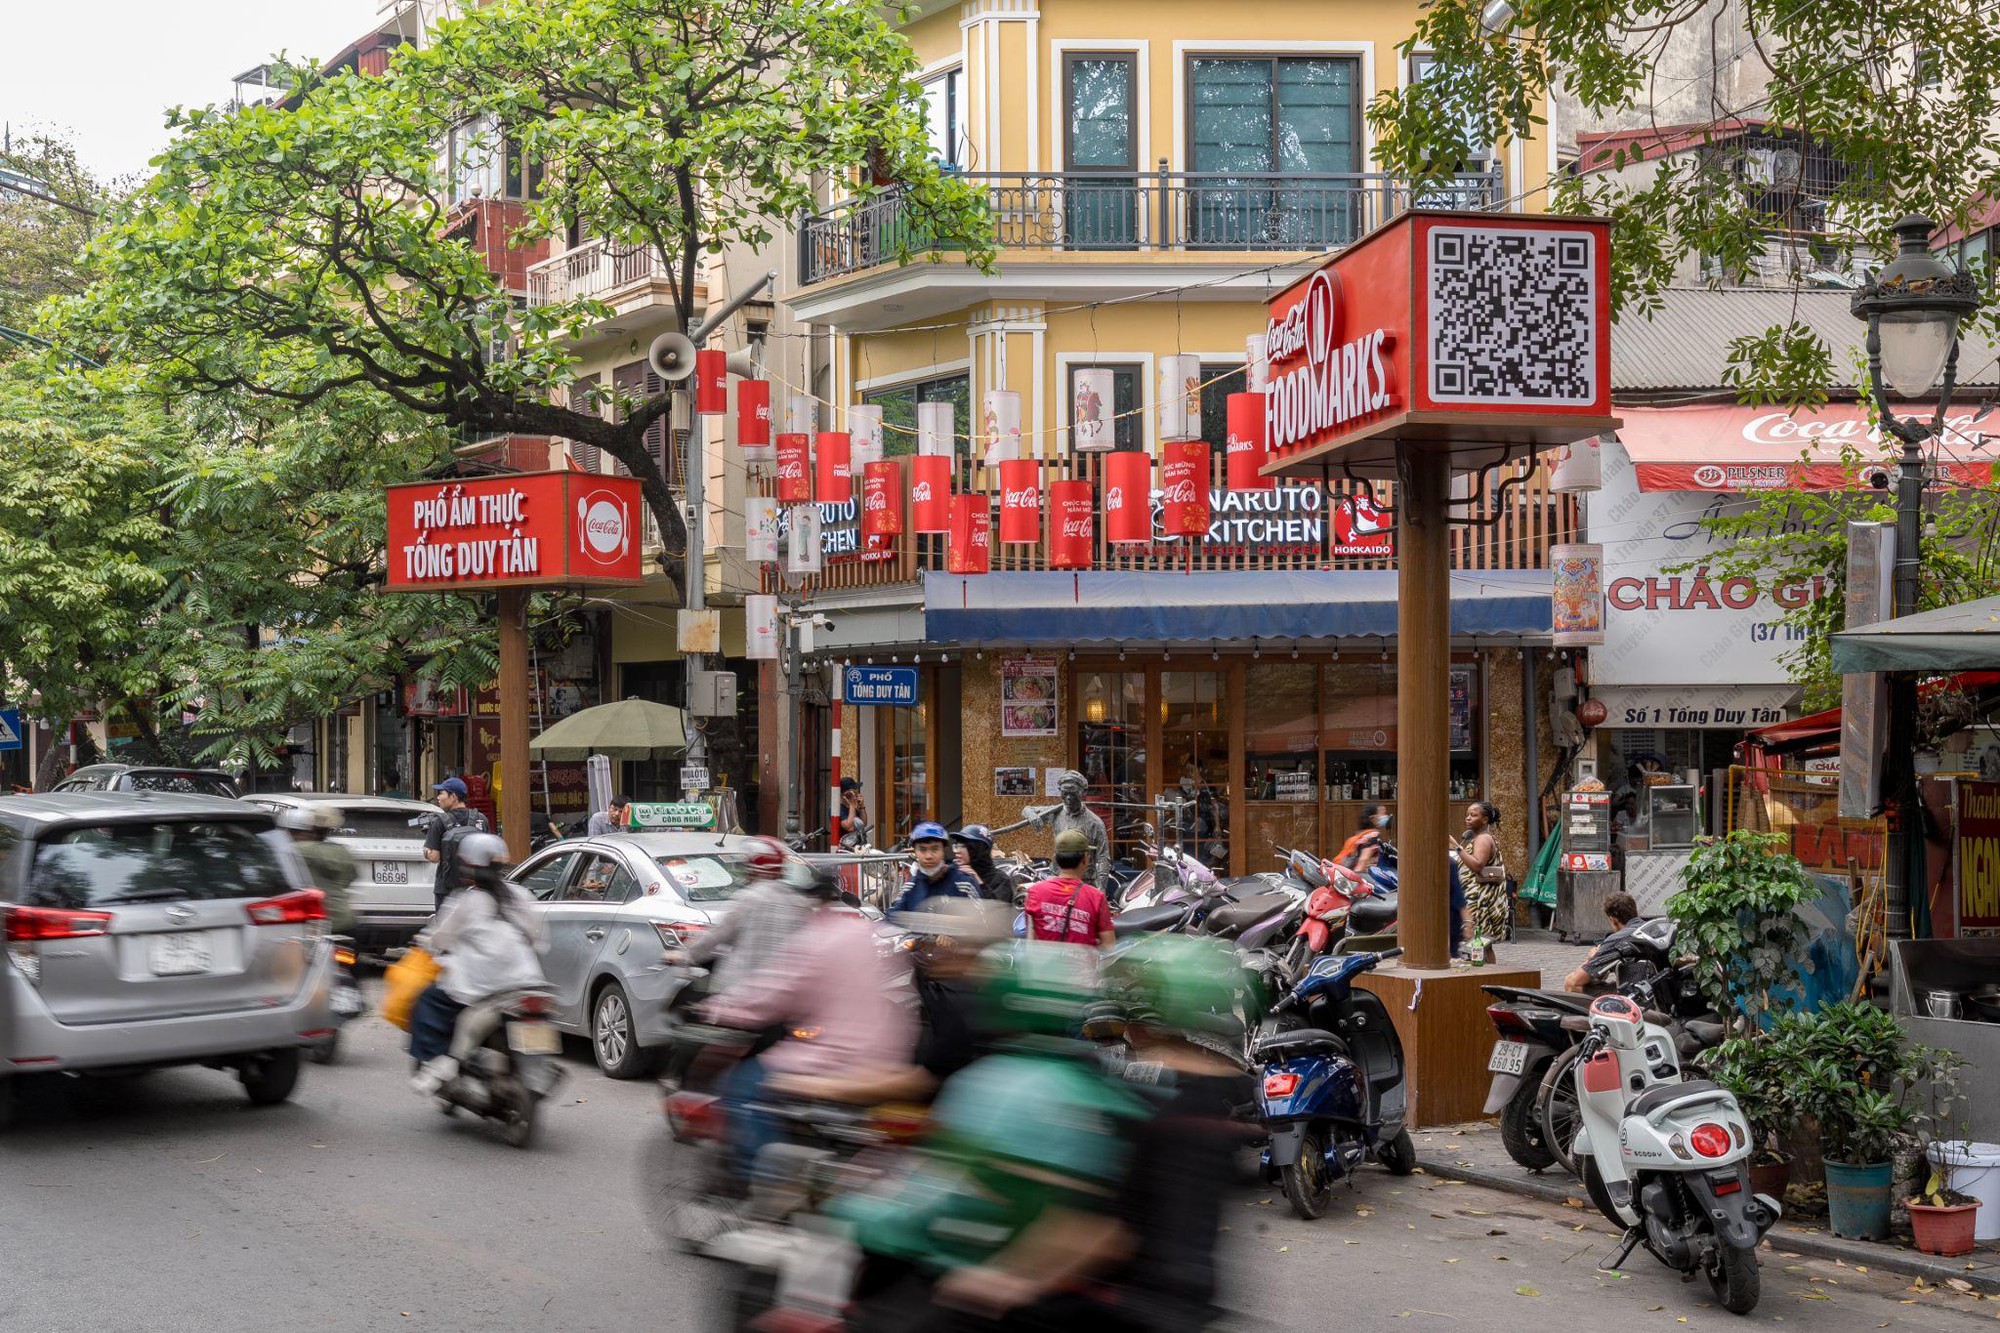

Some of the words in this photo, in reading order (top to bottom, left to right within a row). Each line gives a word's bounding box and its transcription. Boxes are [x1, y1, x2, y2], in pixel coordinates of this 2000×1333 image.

[1727, 466, 1787, 478] PILSNER
[414, 487, 447, 529] PHỐ
[450, 484, 476, 527] ẨM
[479, 487, 527, 530] THỰC
[1208, 486, 1321, 512] NARUTO
[1204, 518, 1322, 543] KITCHEN
[404, 531, 453, 579] TỐNG
[458, 540, 498, 576] DUY
[500, 528, 538, 574] TÂN
[1334, 546, 1391, 554] HOKKAIDO
[1608, 566, 1760, 611] CHÁO
[869, 670, 893, 681] PHỐ
[853, 682, 874, 698] TỐNG
[876, 685, 892, 698] DUY
[894, 682, 911, 698] TÂN
[1625, 706, 1649, 724] Số
[1653, 709, 1662, 723] 1
[1668, 706, 1708, 725] Tống
[1713, 708, 1746, 725] Duy
[1751, 708, 1781, 723] Tân
[382, 862, 400, 873] 30A
[376, 872, 406, 883] 966.96
[1497, 1043, 1523, 1056] 29-C1
[1491, 1056, 1521, 1073] 660.95
